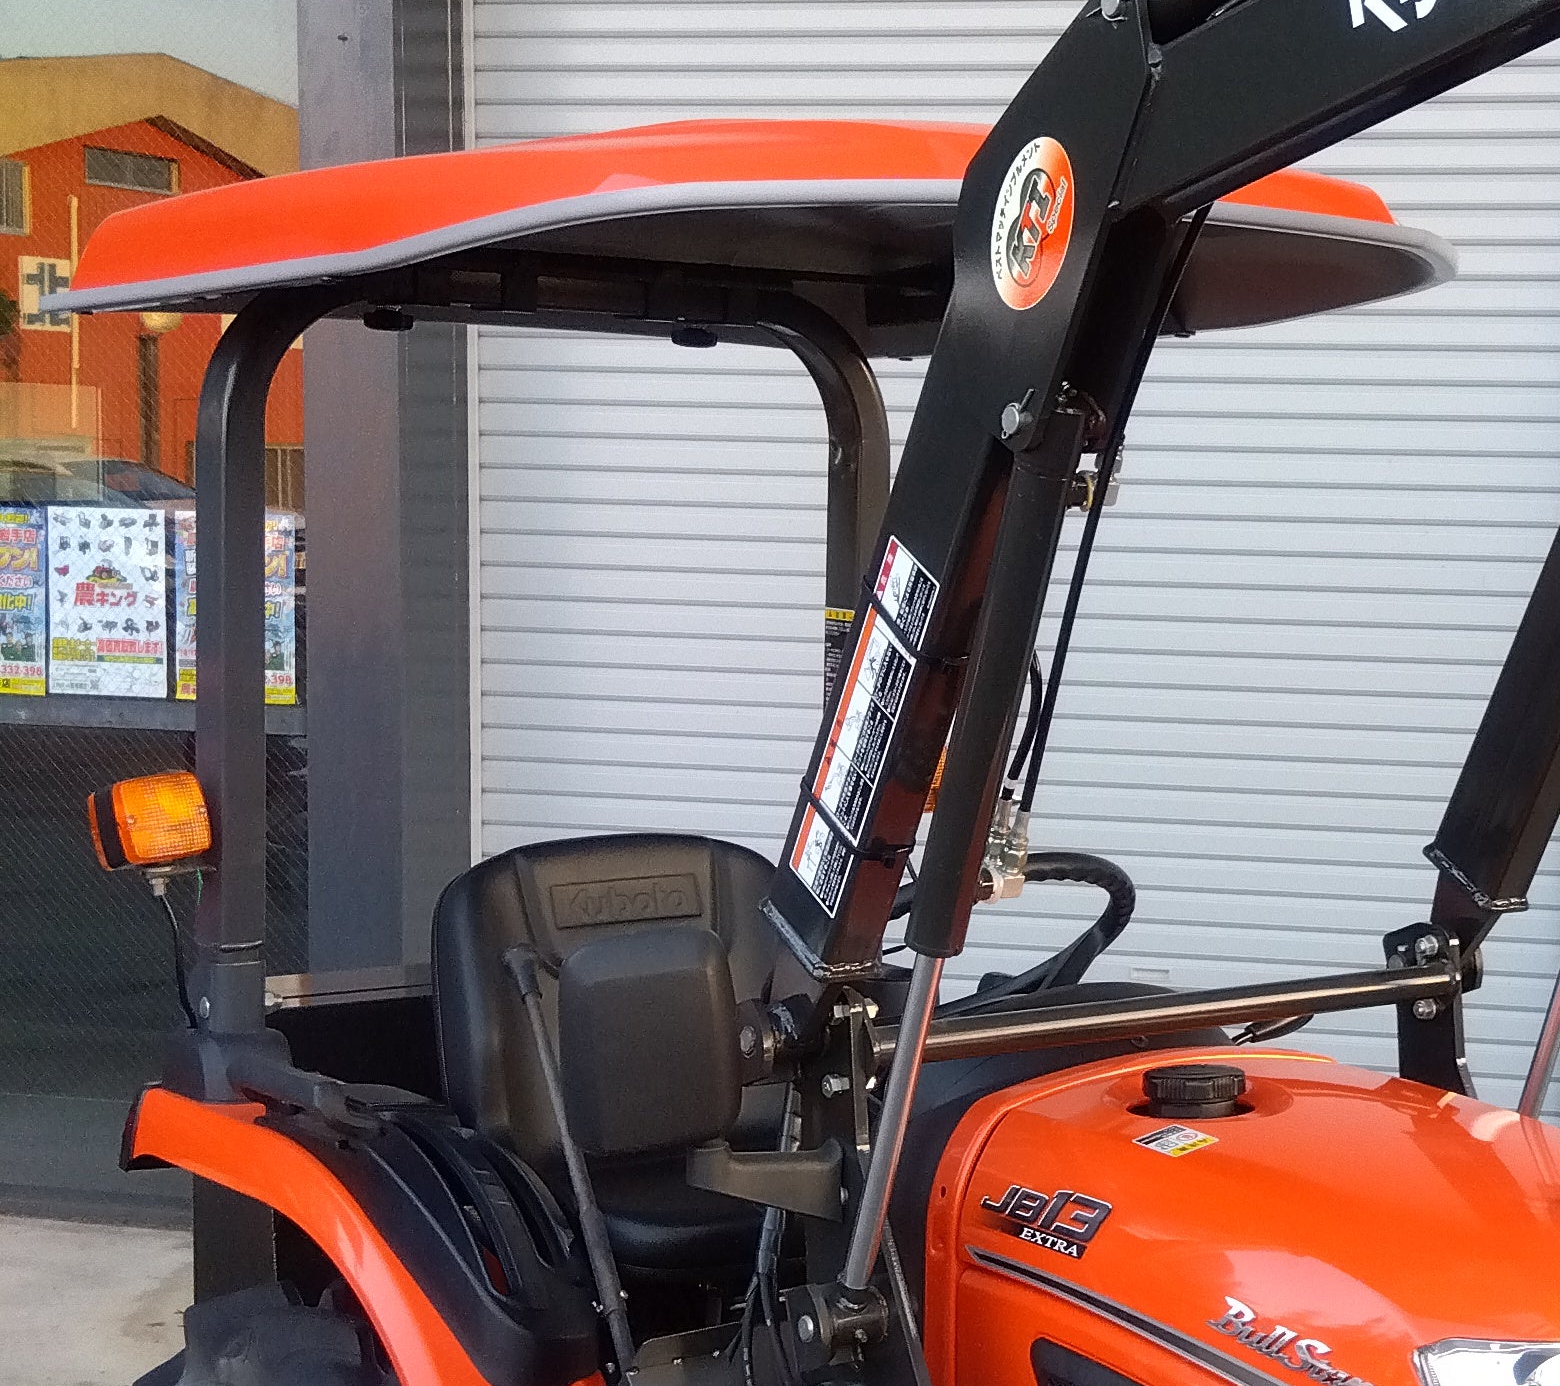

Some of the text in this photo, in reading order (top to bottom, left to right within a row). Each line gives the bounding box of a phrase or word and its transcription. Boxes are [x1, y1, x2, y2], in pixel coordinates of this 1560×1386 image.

[1011, 176, 1051, 278] KTI
[1047, 177, 1068, 233] Special
[74, 582, 138, 606] 農キング
[566, 881, 690, 917] Kubota
[981, 1184, 1112, 1243] JB13
[1020, 1227, 1079, 1257] EXTRA
[1205, 1295, 1299, 1359] Bull
